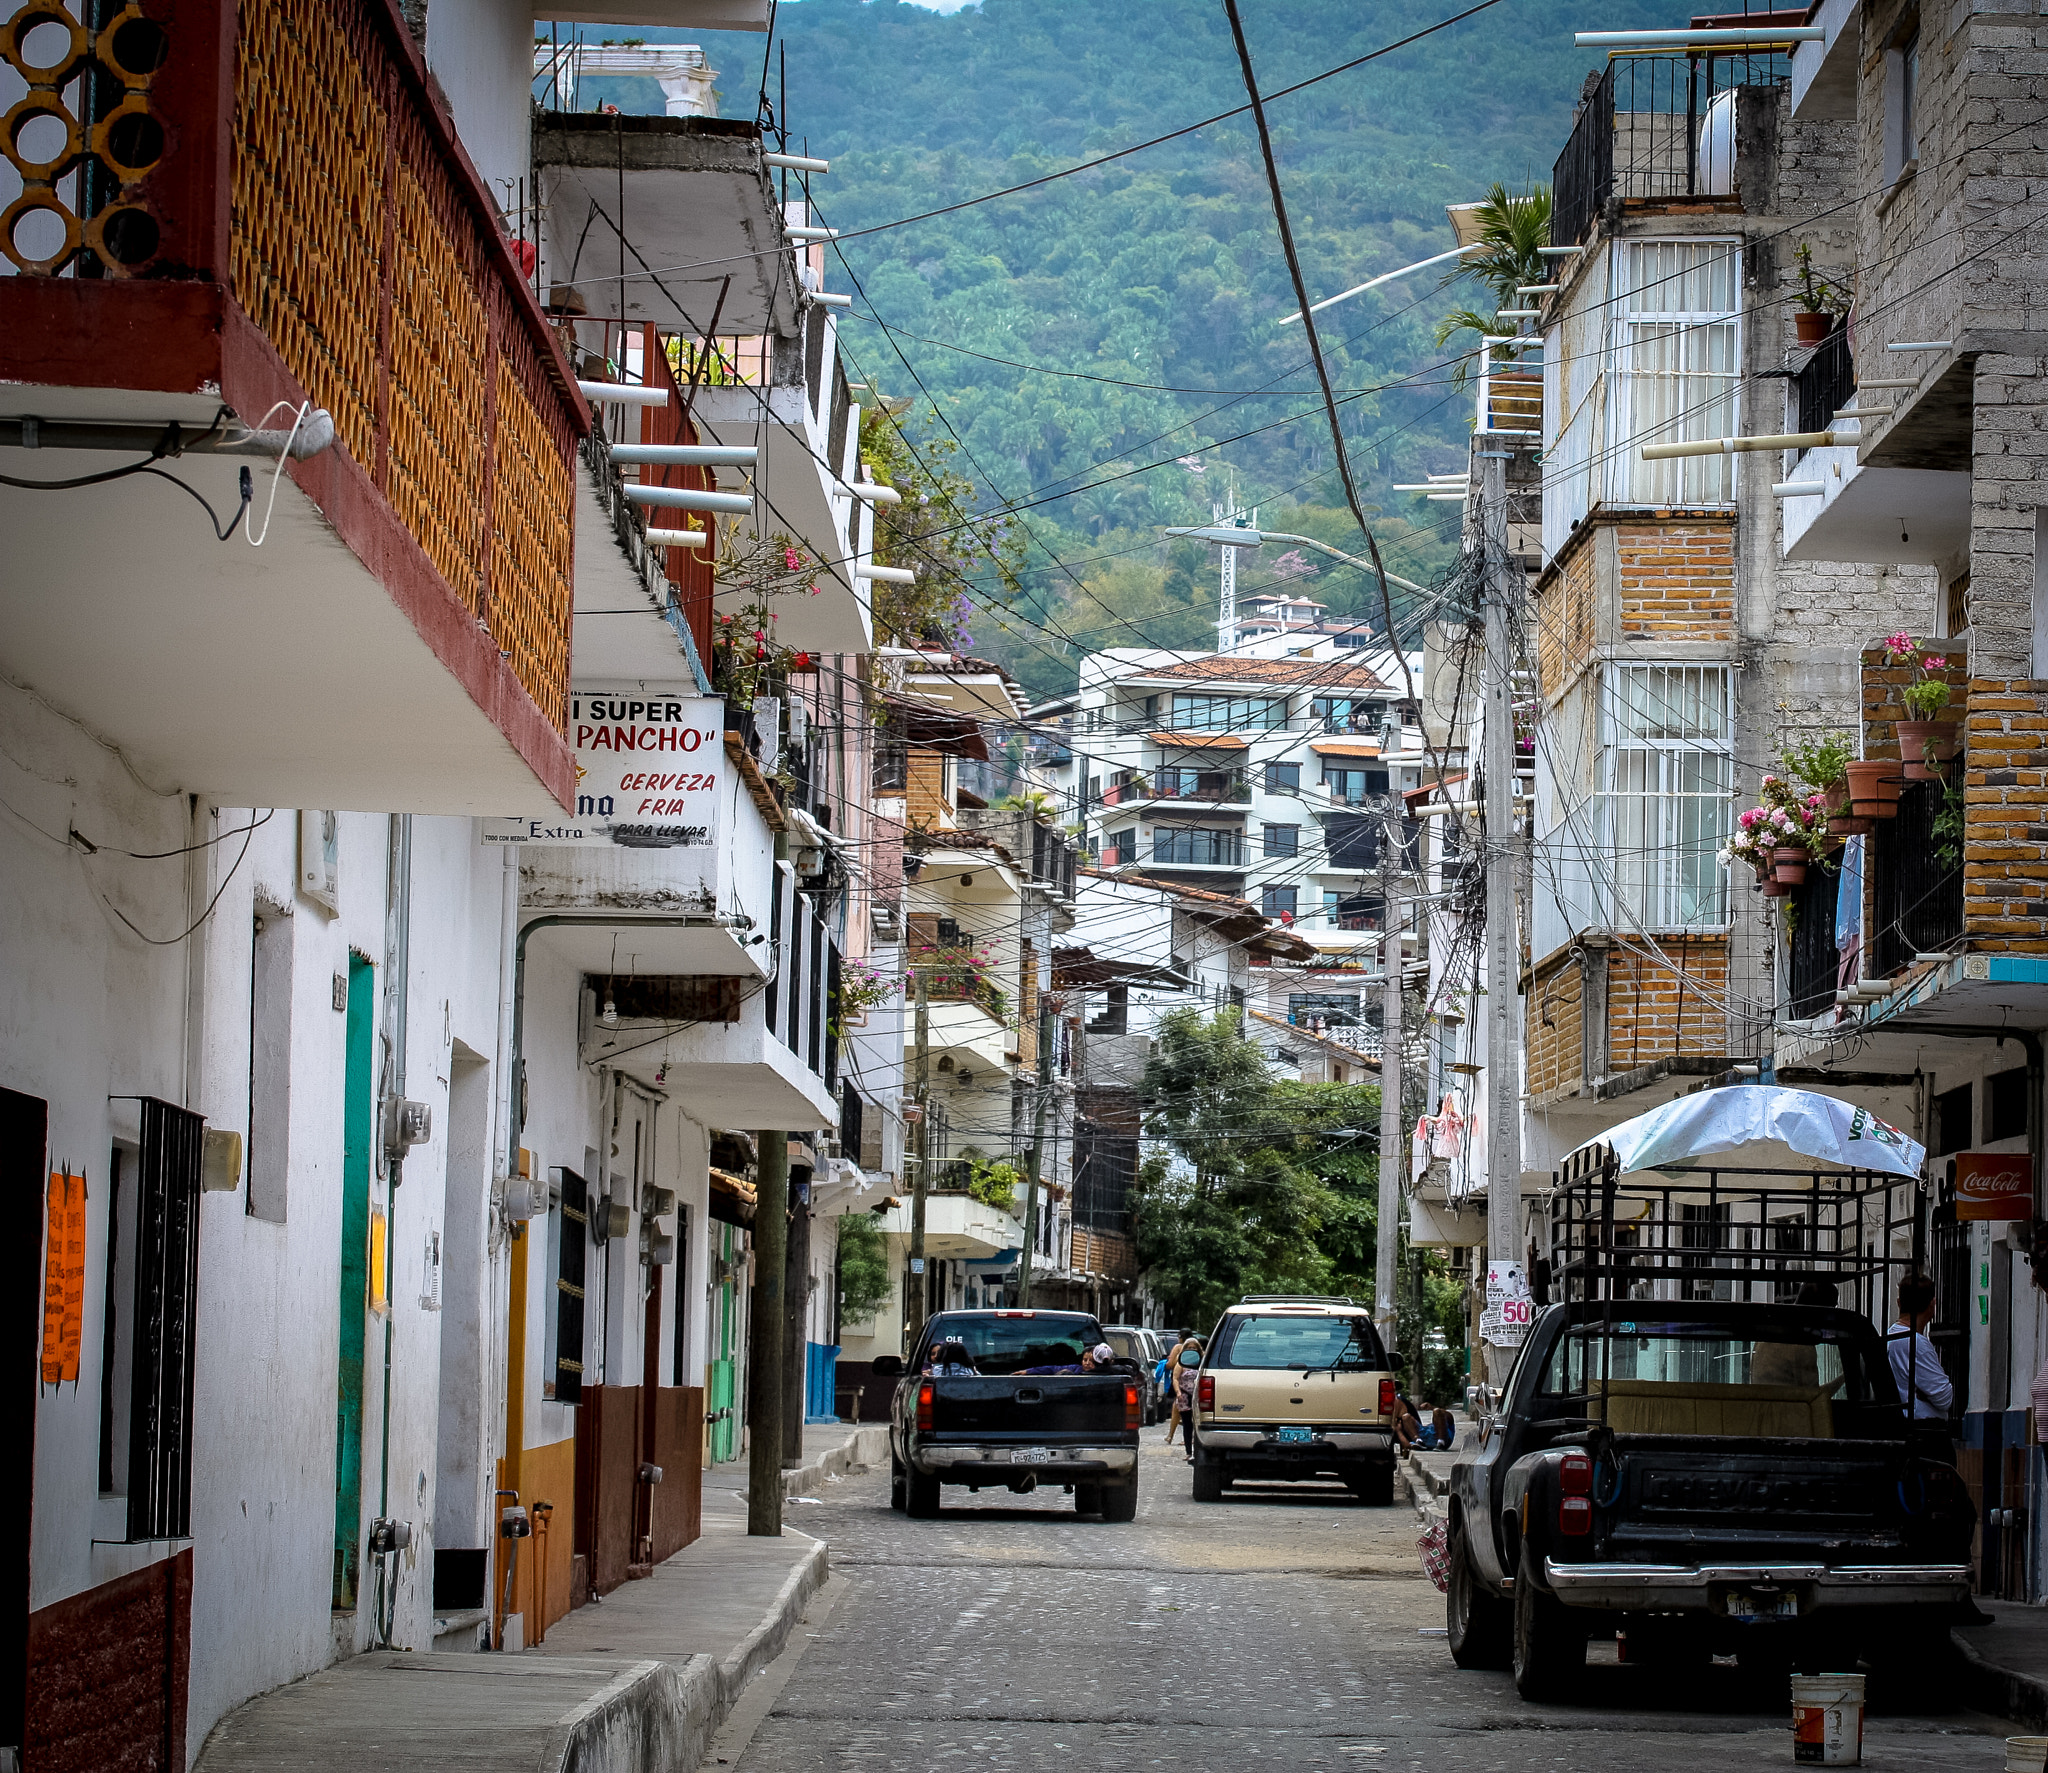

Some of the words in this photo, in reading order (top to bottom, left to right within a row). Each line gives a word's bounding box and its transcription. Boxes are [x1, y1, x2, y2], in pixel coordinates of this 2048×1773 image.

[590, 701, 683, 722] SUPER
[620, 773, 715, 792] CERVEZA
[637, 798, 685, 816] FRIA
[529, 821, 583, 839] Extra
[616, 823, 653, 837] PARA
[656, 824, 708, 838] LLEVAR
[1963, 1171, 2023, 1192] Coca-Cola
[1503, 1301, 1529, 1323] 50
